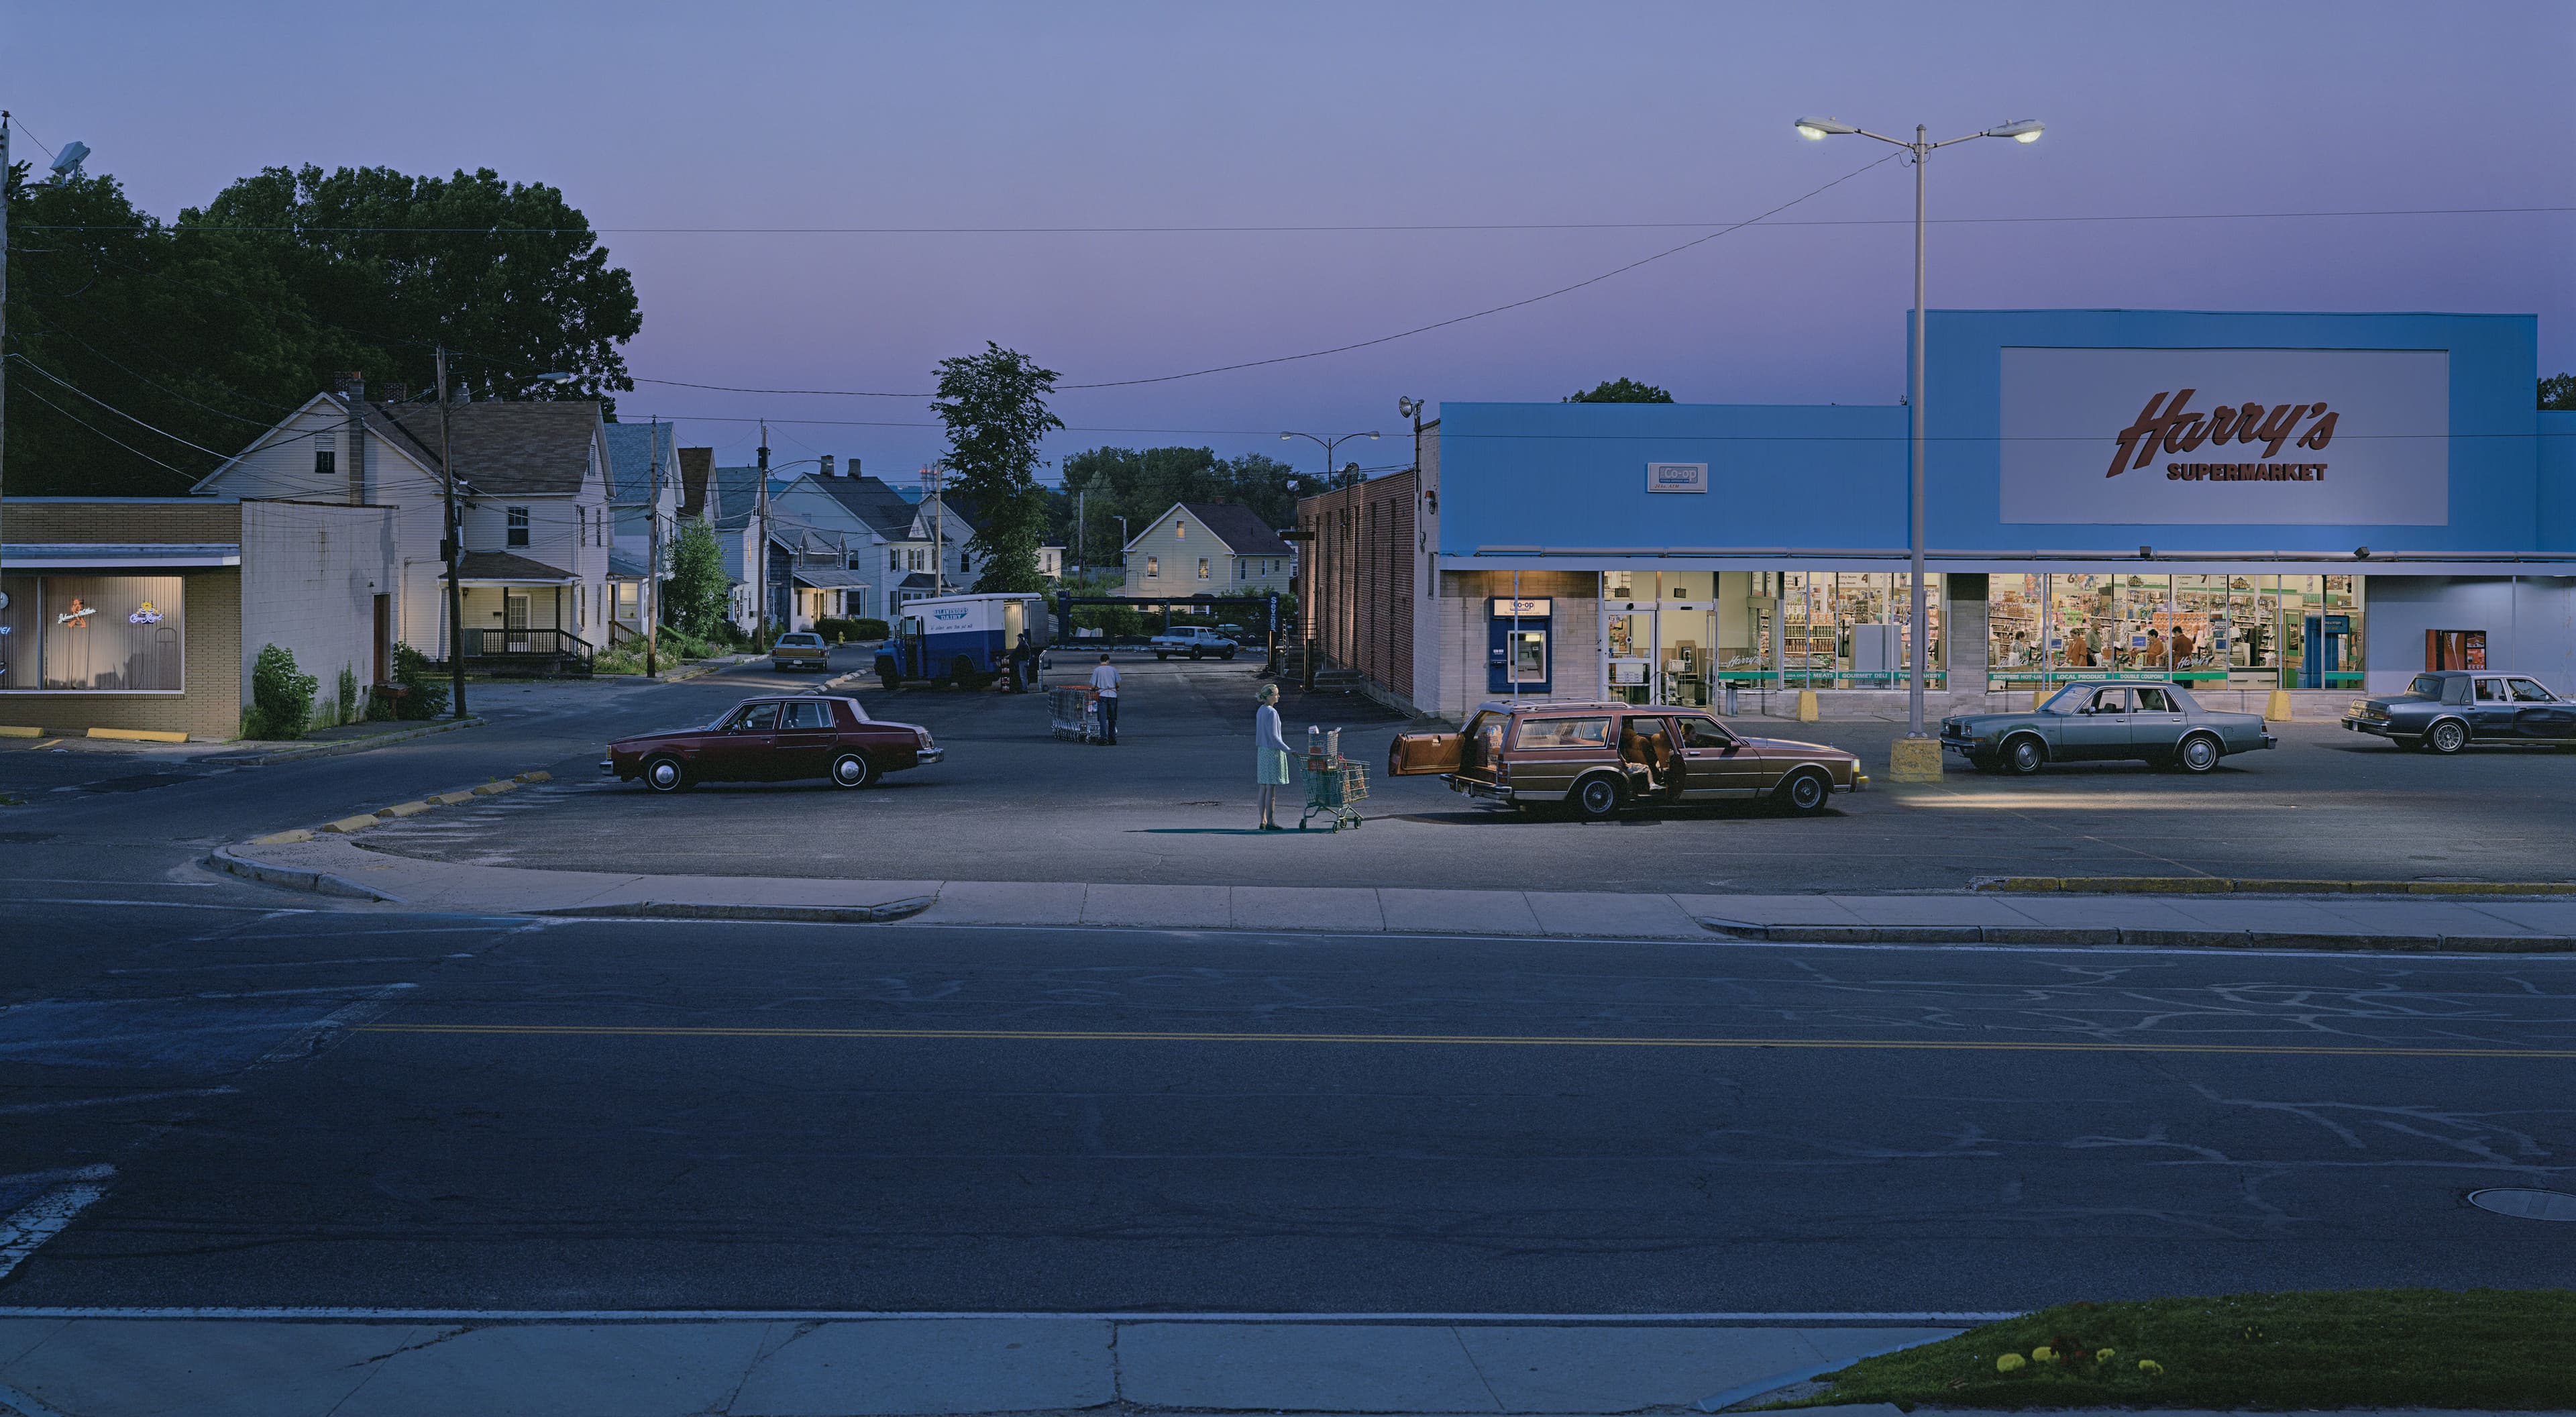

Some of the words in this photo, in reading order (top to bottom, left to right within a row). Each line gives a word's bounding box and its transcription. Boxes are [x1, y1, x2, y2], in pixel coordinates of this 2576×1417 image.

[2106, 388, 2340, 478] Harry's
[2166, 462, 2328, 482] SUPERMARKET
[1861, 574, 1868, 583] 4
[2067, 574, 2075, 583] 6
[2201, 574, 2208, 583] 7
